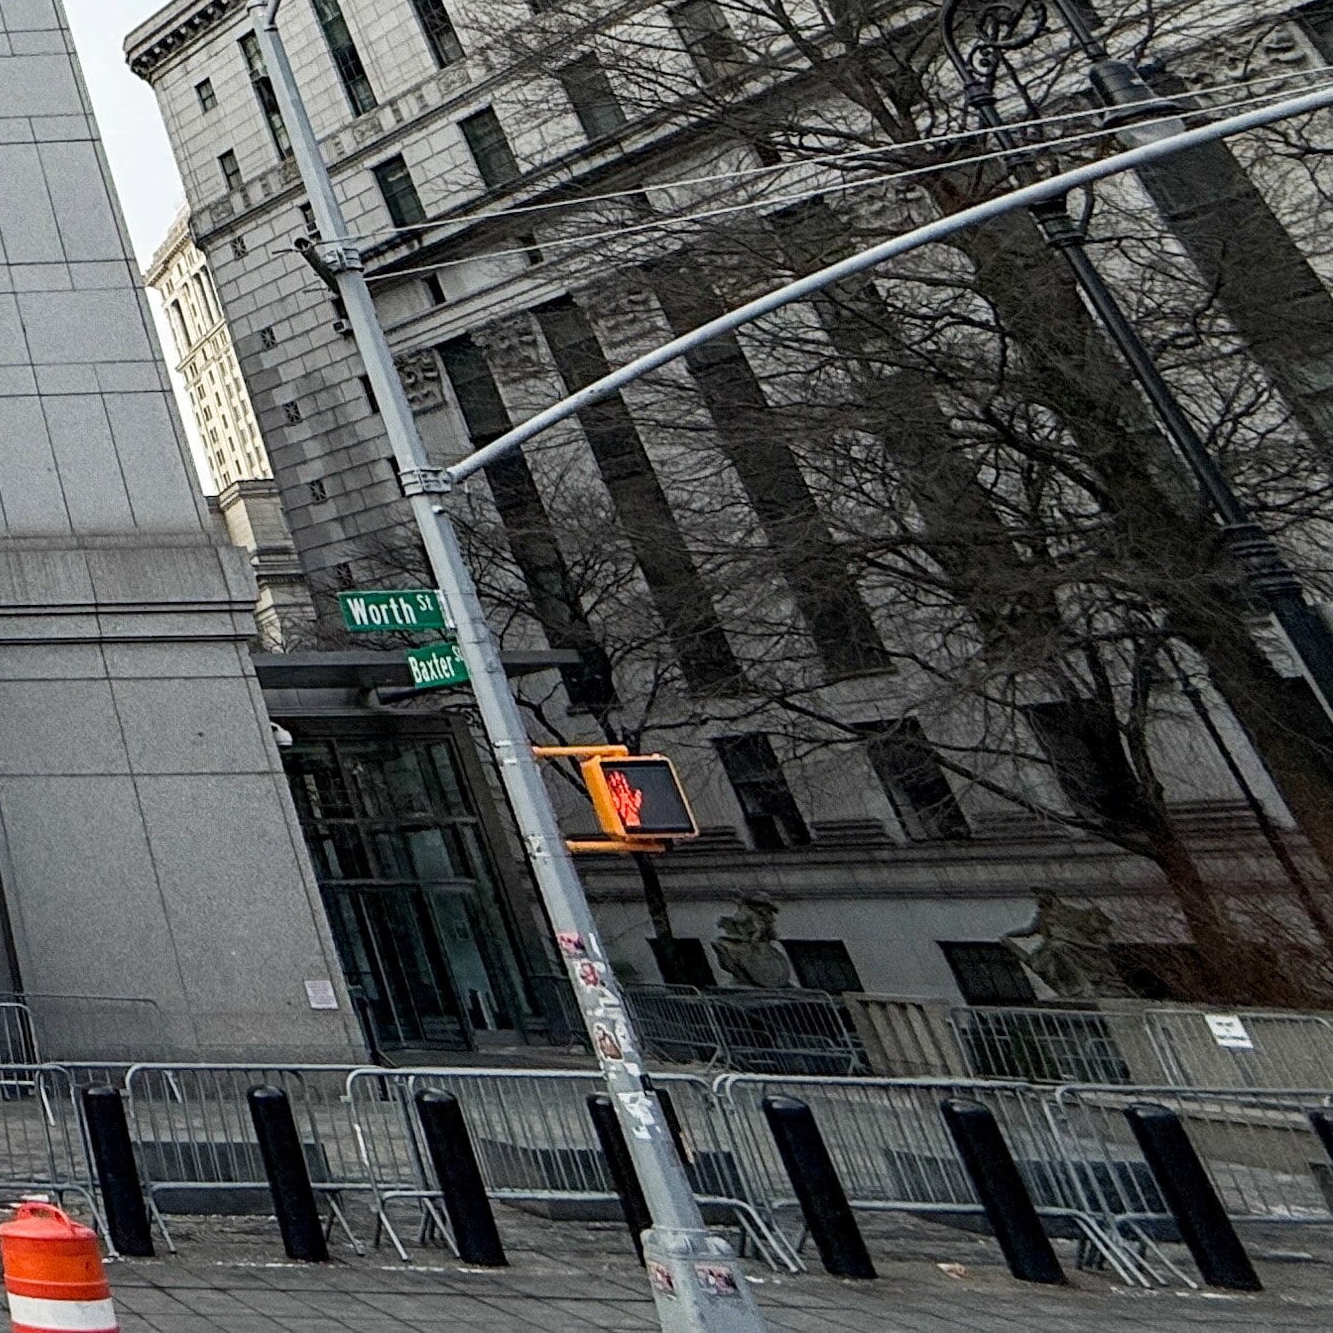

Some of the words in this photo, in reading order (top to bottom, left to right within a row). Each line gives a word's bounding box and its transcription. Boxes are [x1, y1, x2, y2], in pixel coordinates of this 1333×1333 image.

[346, 597, 418, 626] Worth
[416, 594, 434, 612] St
[408, 652, 456, 684] Baxter
